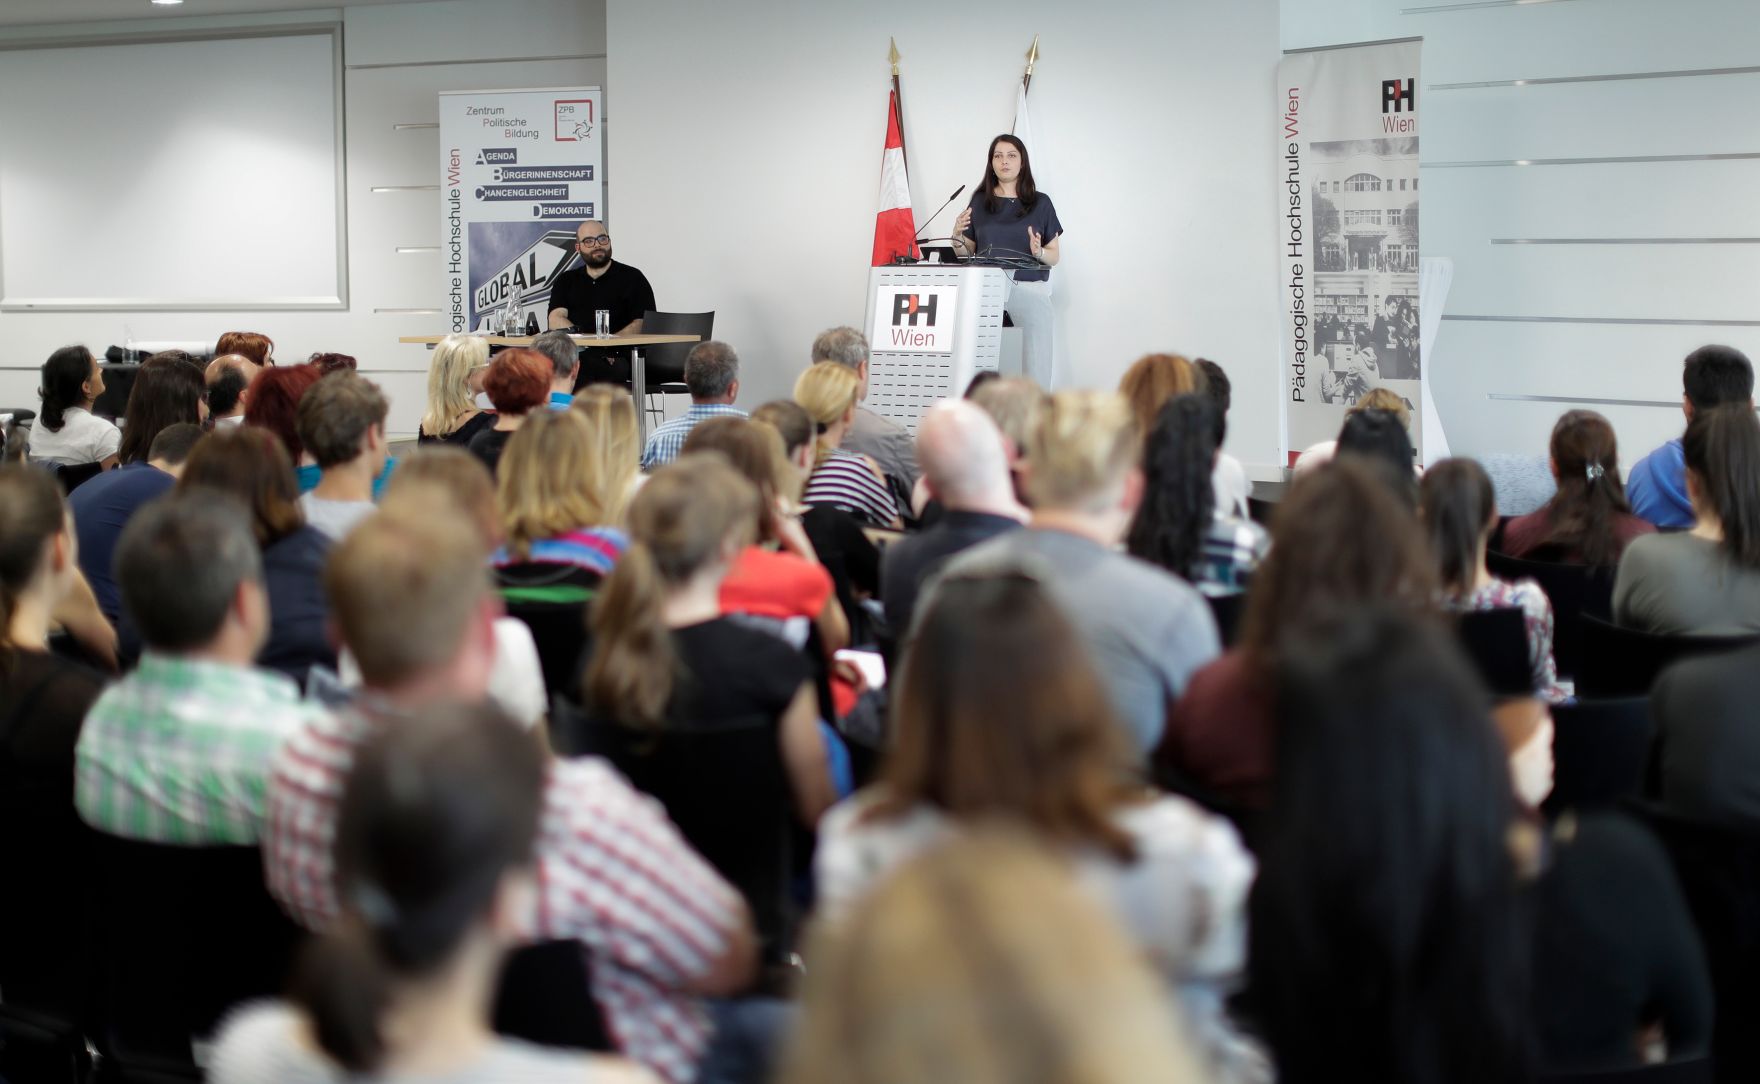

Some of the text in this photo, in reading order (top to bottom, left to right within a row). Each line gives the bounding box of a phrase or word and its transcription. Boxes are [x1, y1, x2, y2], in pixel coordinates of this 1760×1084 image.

[466, 106, 505, 116] Zentrum
[558, 105, 575, 114] ZPB
[483, 118, 527, 128] Politische
[1382, 115, 1415, 133] Wien
[504, 129, 539, 140] Bildung
[475, 151, 516, 165] AGENDA
[492, 167, 592, 182] BÜRGERINNENSCHAFT
[474, 185, 567, 201] CHANCENGLEICHHEIT
[532, 203, 593, 219] DEMOKRATIE
[447, 148, 466, 333] ogische Hochschule Wien
[1284, 87, 1308, 402] Pädagogische Hochschule Wien
[477, 251, 547, 309] GLOBAL
[891, 328, 935, 347] Wien
